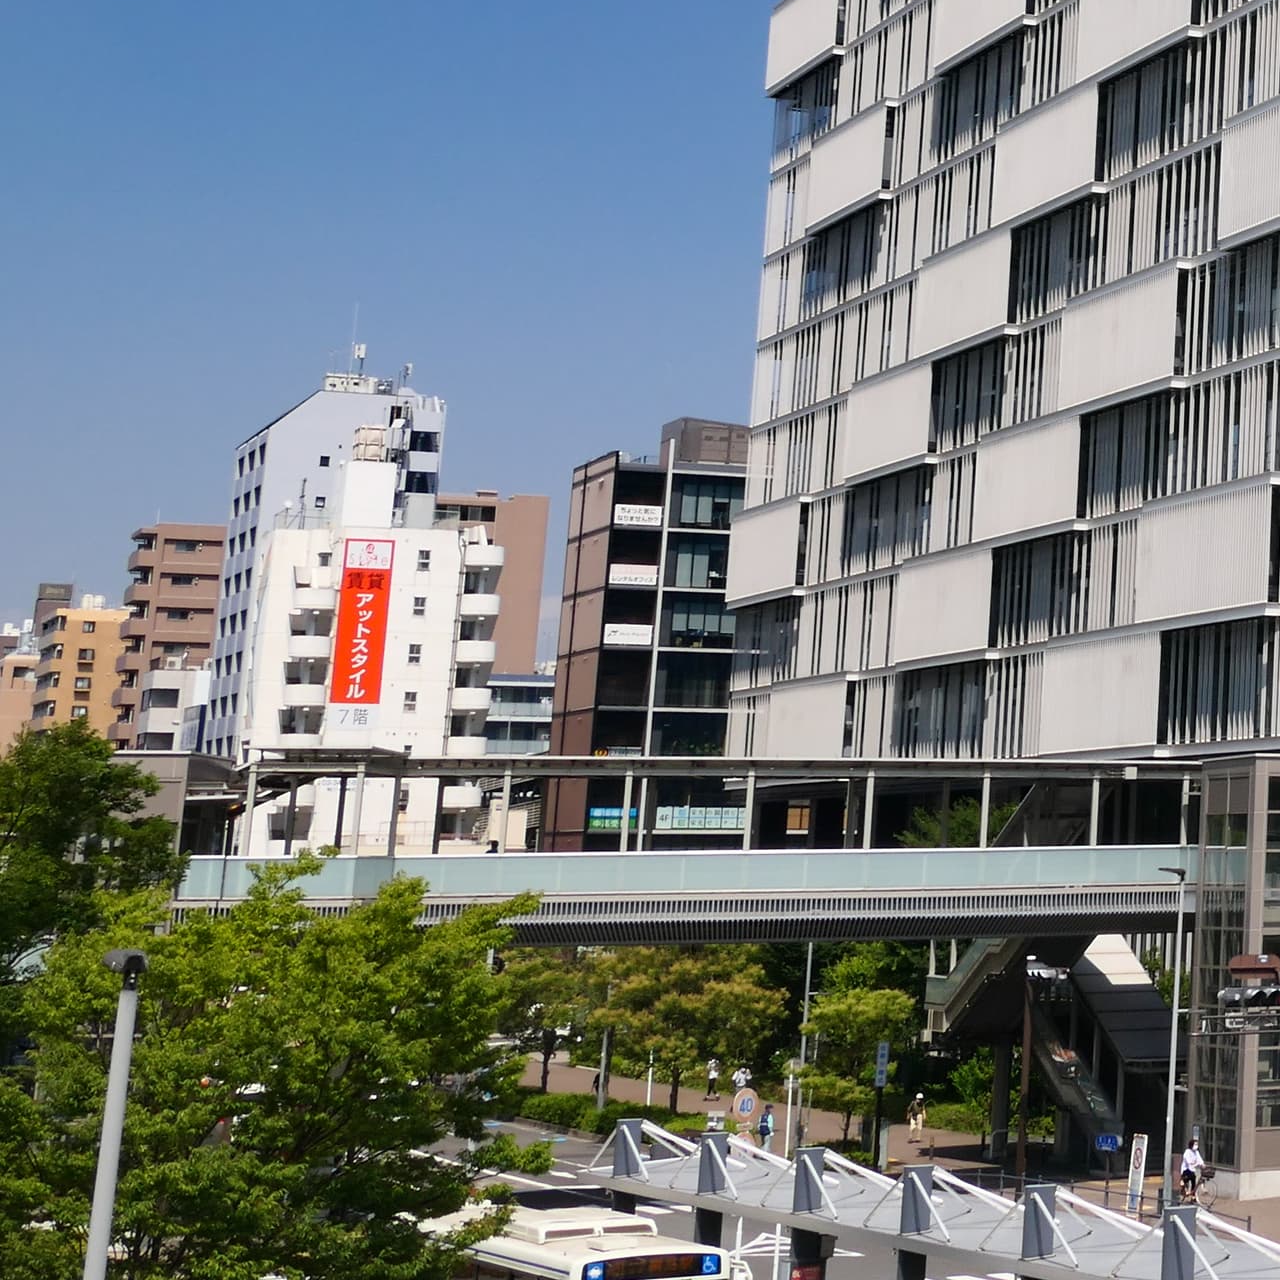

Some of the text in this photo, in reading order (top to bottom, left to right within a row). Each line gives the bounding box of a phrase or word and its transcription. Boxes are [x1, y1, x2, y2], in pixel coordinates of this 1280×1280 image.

[346, 593, 375, 699] アットスタイル
[739, 1097, 755, 1113] 40
